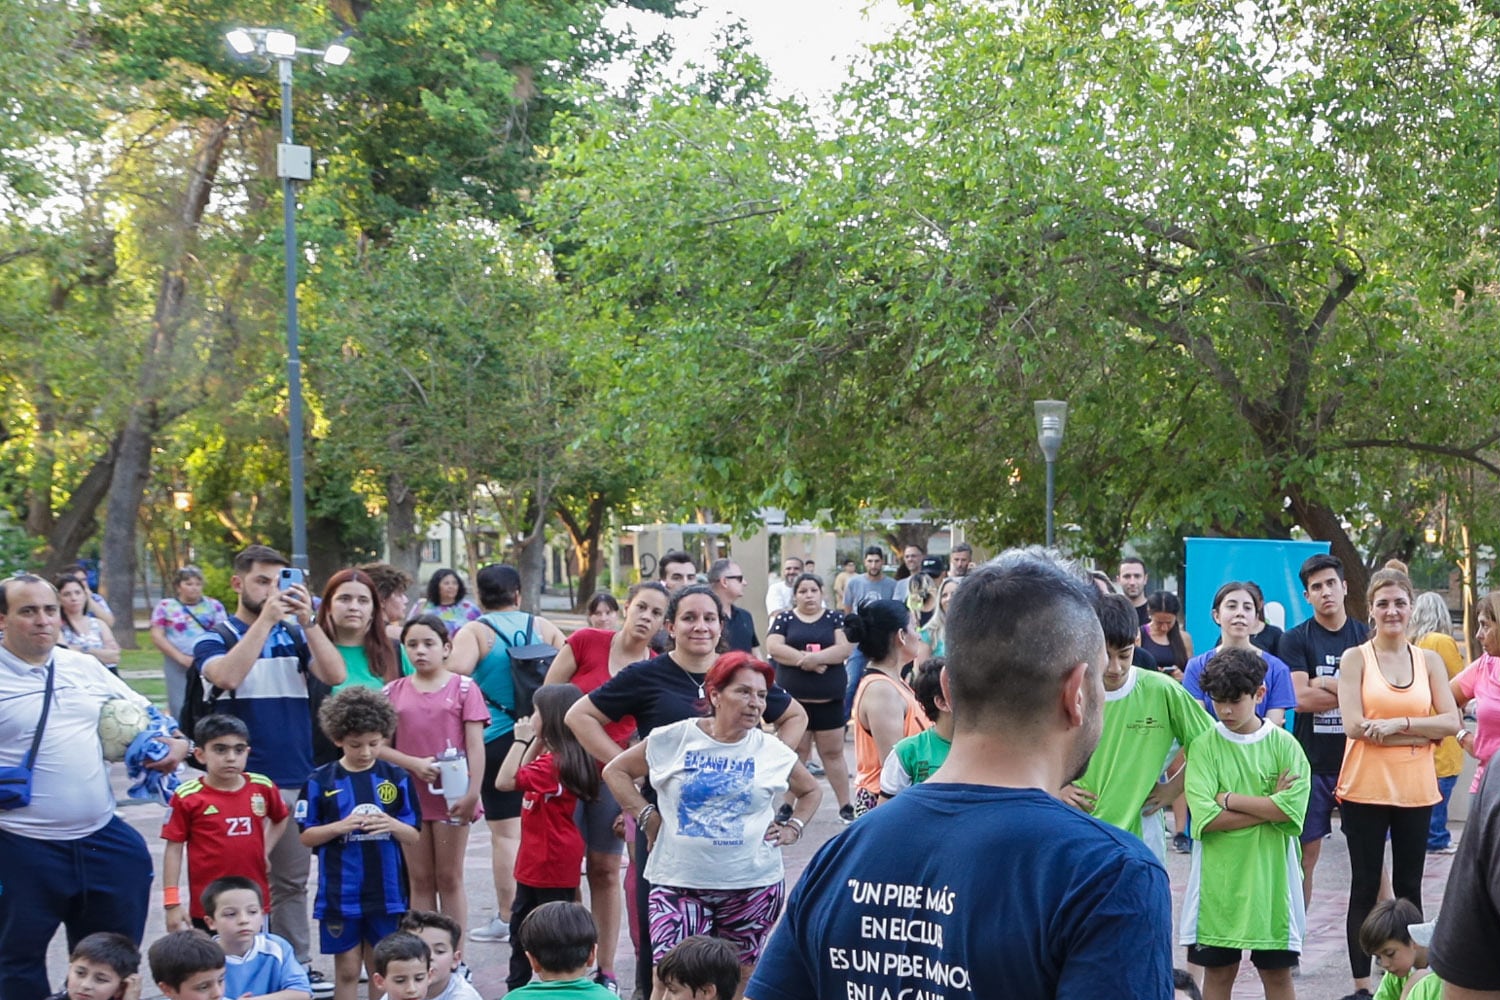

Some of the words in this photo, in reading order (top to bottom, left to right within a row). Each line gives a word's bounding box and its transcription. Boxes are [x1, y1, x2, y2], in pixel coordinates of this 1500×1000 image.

[225, 817, 252, 836] 23
[884, 883, 923, 908] PIBE
[926, 885, 956, 915] MÁS
[861, 916, 887, 940] EN
[890, 918, 907, 941] EL
[829, 947, 850, 969] ES
[852, 950, 880, 974] UN
[884, 953, 923, 977] PIBE
